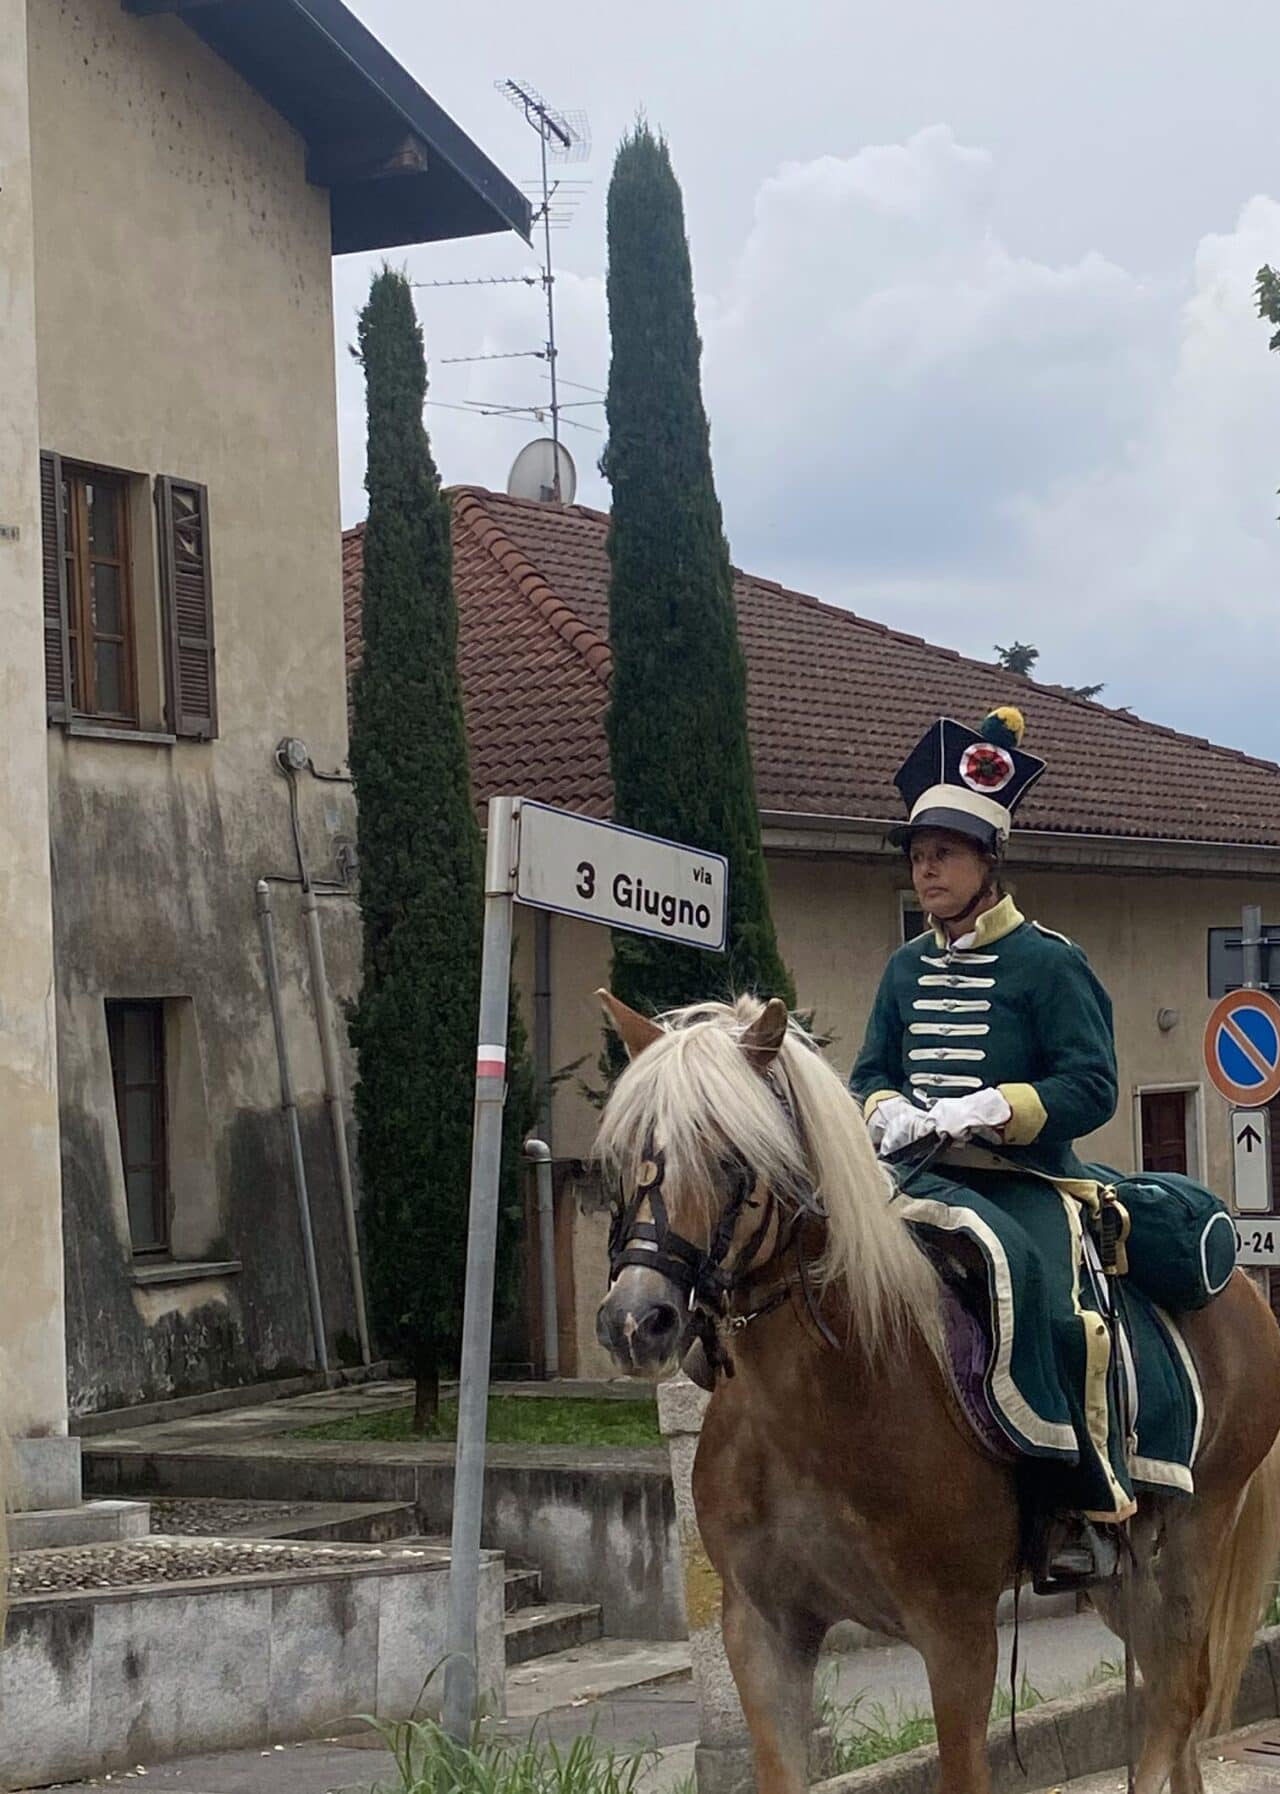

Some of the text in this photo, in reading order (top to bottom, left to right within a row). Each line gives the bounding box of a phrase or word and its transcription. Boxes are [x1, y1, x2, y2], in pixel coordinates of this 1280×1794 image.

[576, 861, 711, 929] 3 Giugno
[693, 867, 712, 885] via
